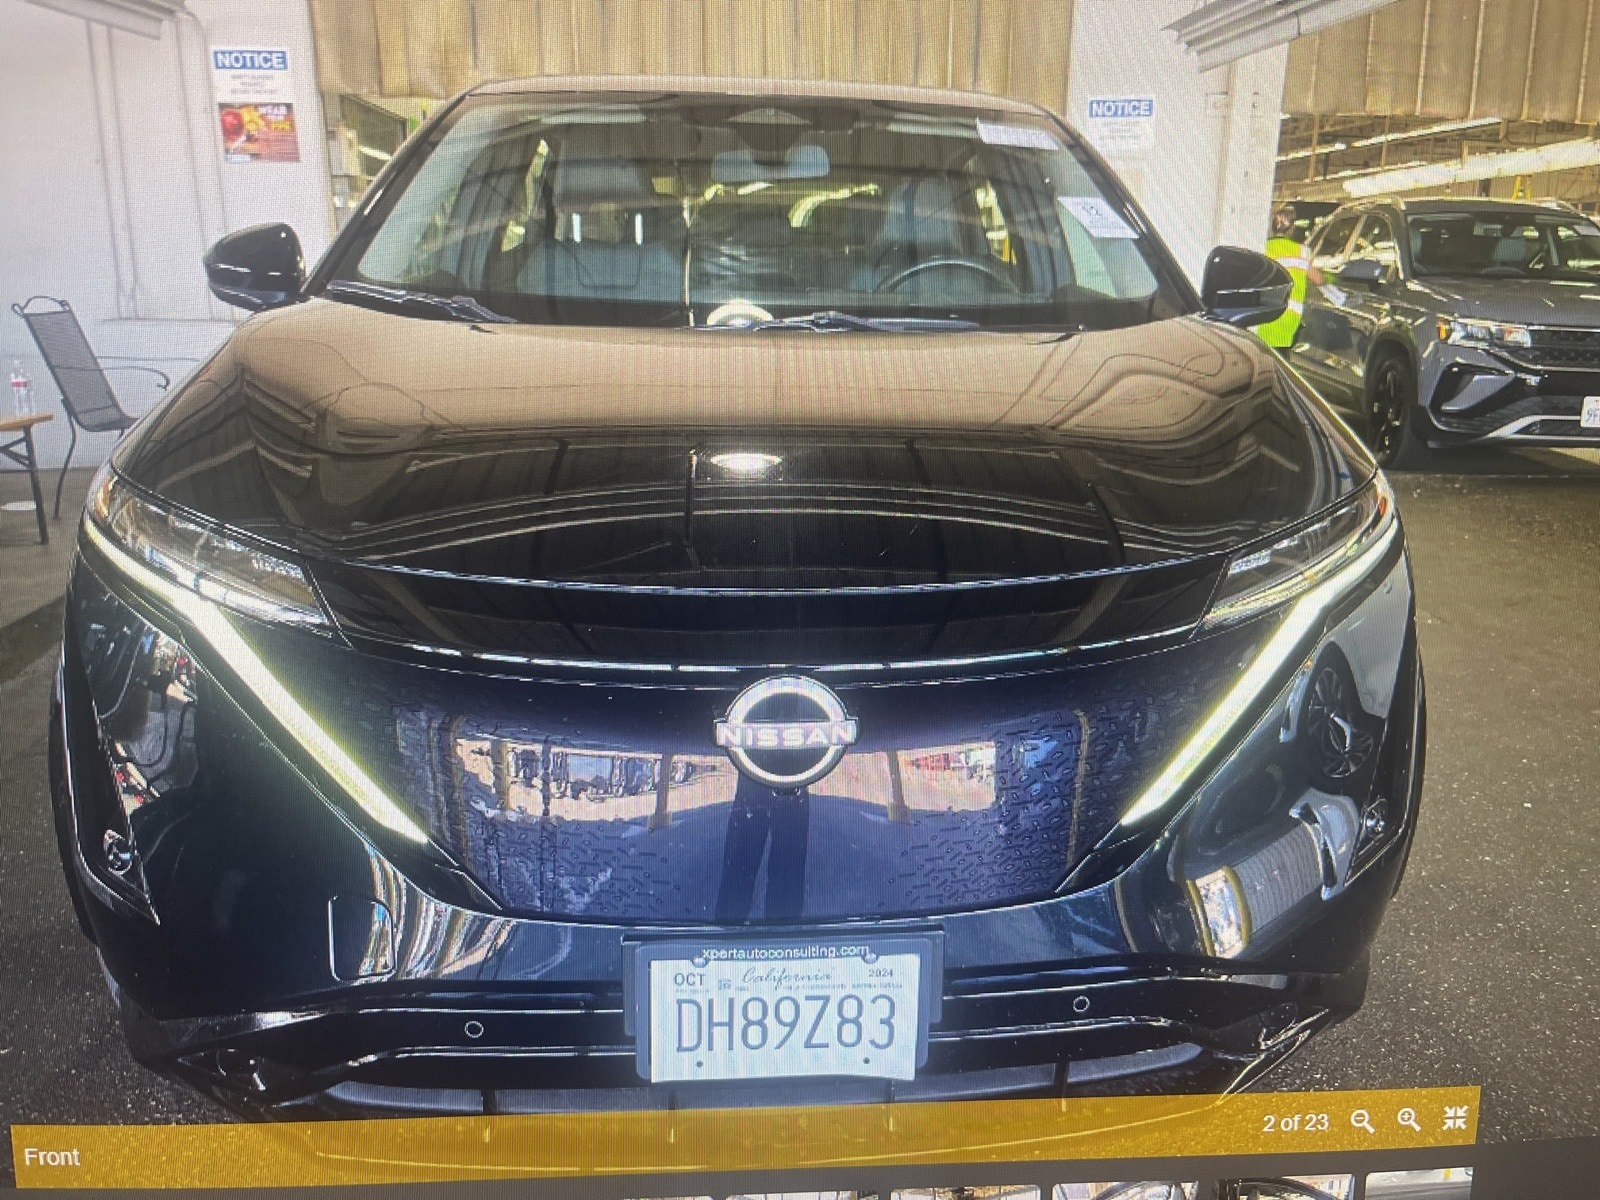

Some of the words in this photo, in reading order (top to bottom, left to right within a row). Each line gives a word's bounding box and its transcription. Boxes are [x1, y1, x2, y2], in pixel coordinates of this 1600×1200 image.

[215, 52, 286, 69] NOTICE
[1091, 101, 1151, 116] NOTICE
[716, 724, 856, 747] NISSAN
[674, 972, 706, 986] OCT
[743, 966, 832, 990] California
[868, 968, 894, 978] 2024
[676, 994, 896, 1052] DH89Z83
[1263, 1115, 1276, 1132] 2
[1280, 1114, 1302, 1131] of
[1304, 1113, 1330, 1131] 23
[24, 1147, 81, 1166] Front
